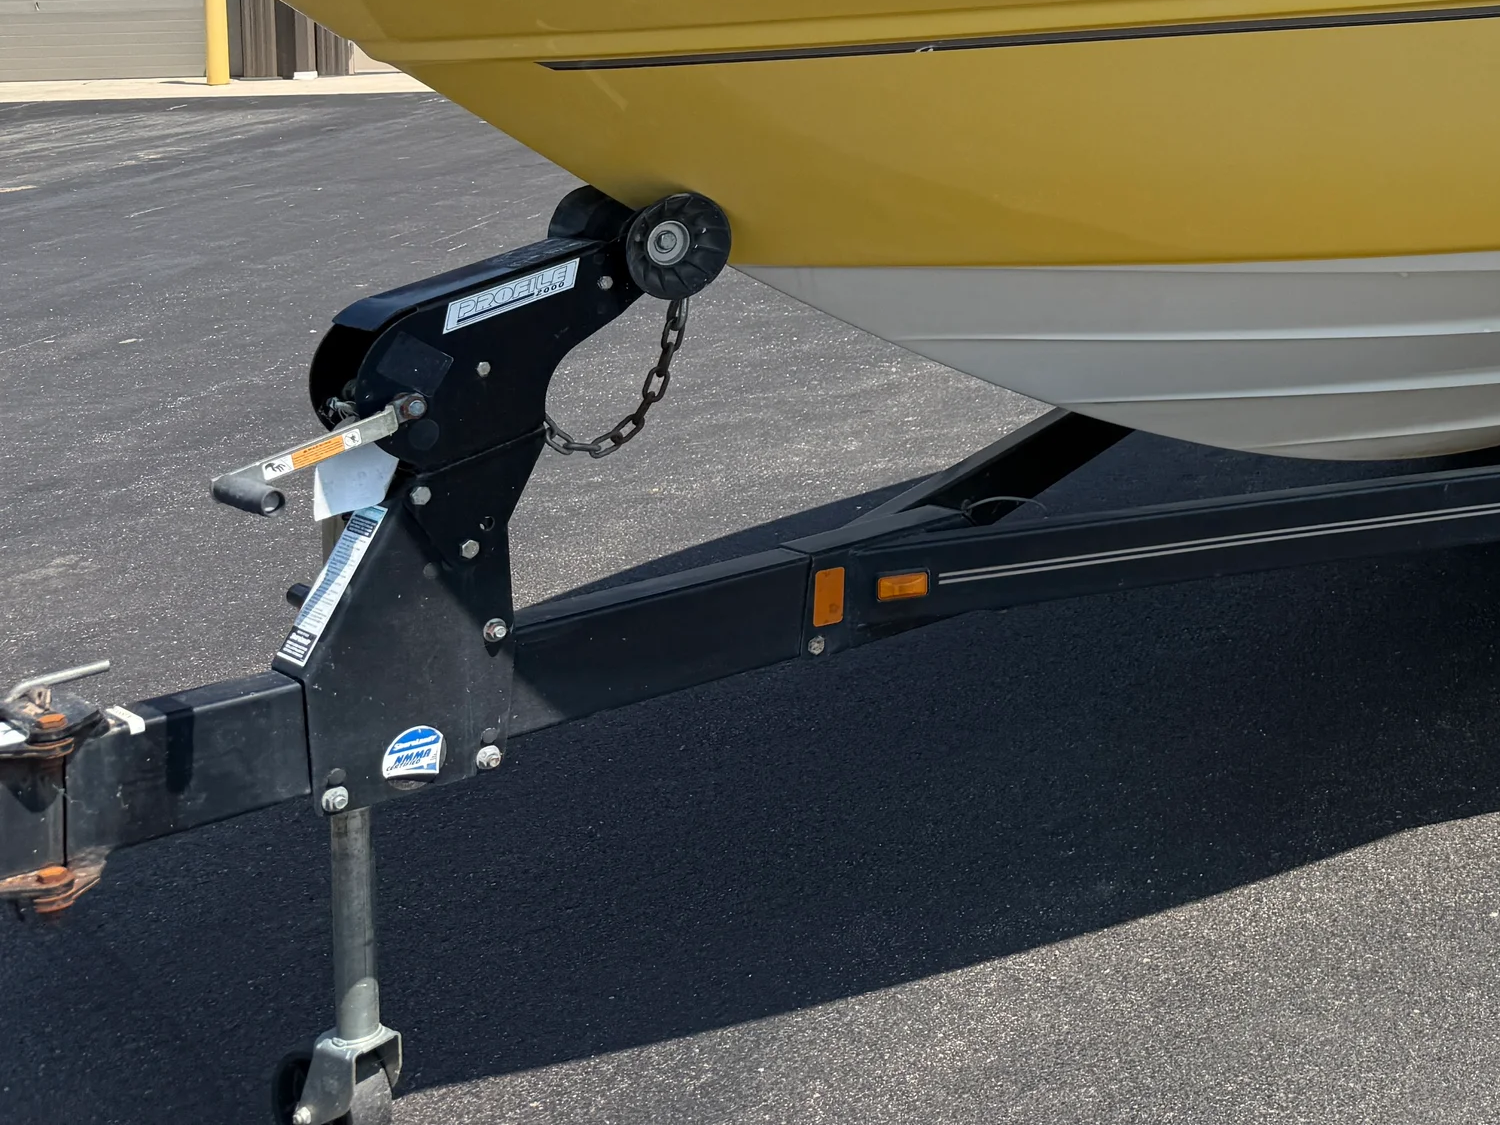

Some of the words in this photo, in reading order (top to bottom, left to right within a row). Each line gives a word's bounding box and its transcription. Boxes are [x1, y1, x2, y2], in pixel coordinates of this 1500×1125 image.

[457, 266, 568, 318] PROFILE
[535, 281, 565, 297] 2000
[393, 748, 432, 766] NMMA
